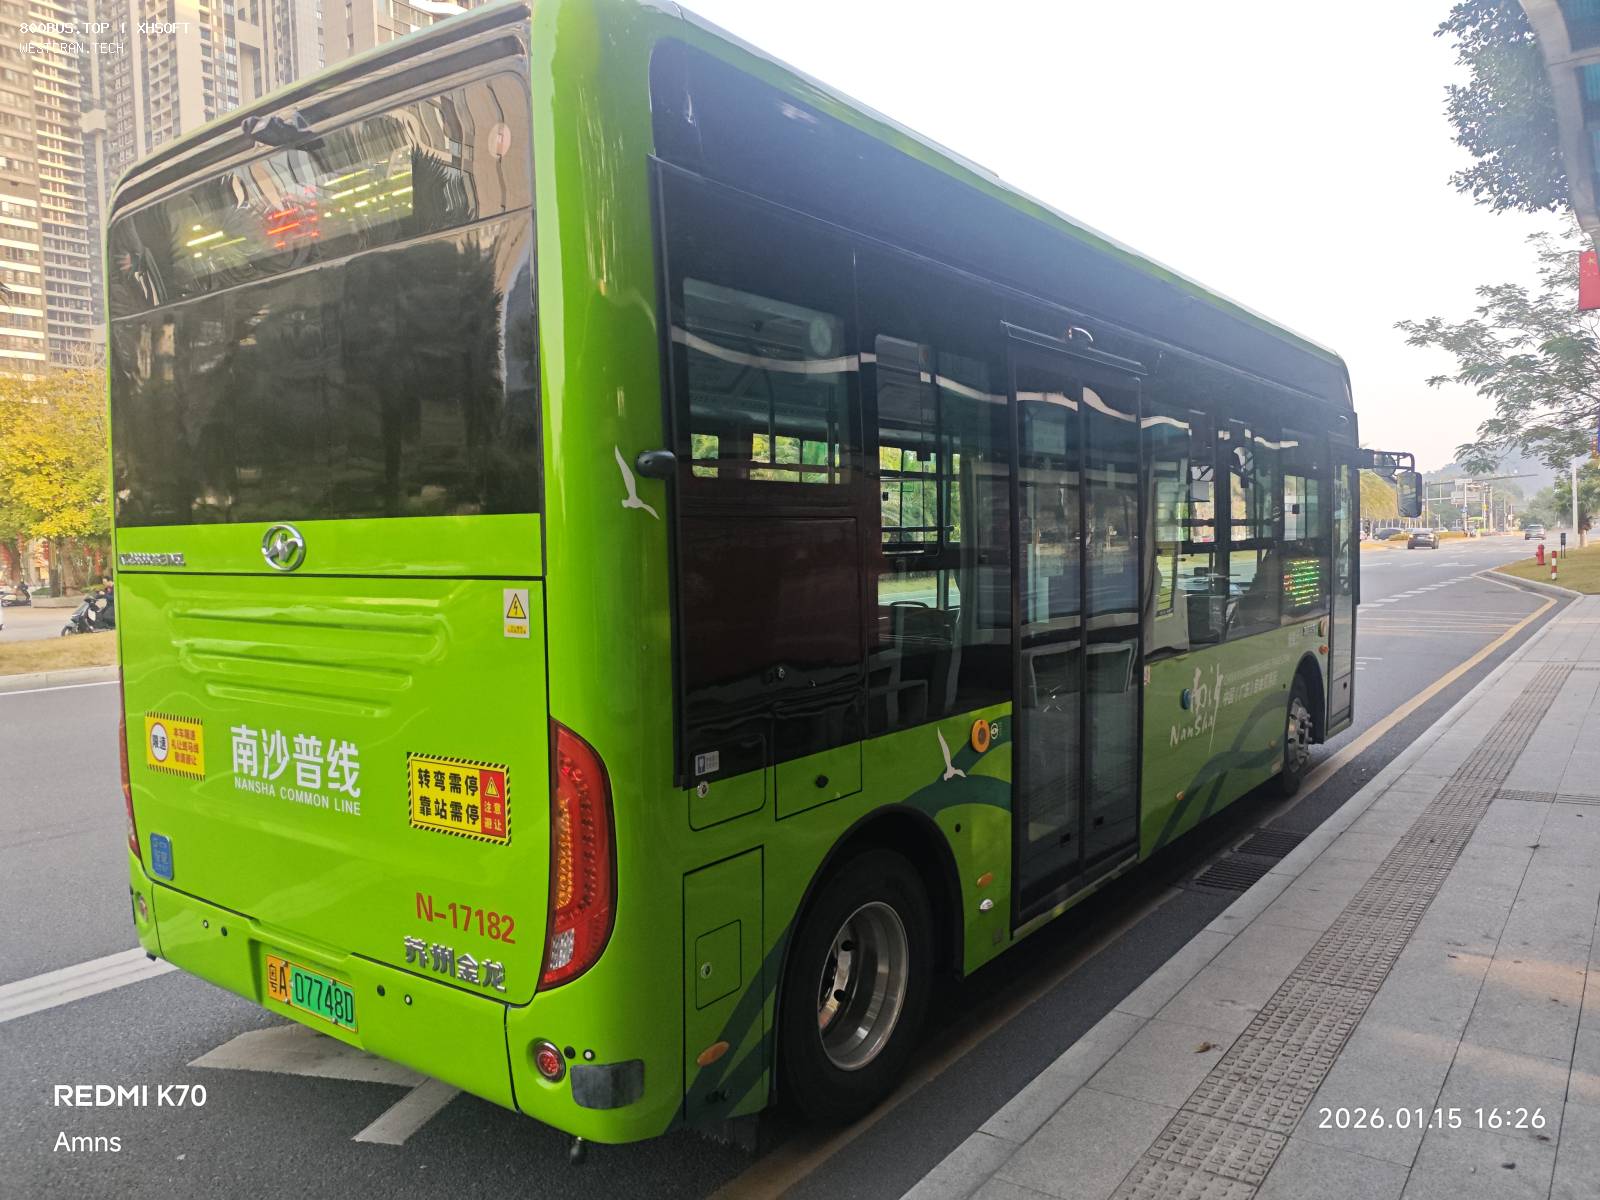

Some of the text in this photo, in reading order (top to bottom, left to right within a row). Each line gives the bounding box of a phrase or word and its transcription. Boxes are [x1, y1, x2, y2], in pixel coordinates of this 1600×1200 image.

[152, 734, 167, 750] 限速
[230, 724, 361, 798] 南沙普线
[234, 776, 361, 816] NANSHA COMMON LINE
[417, 767, 479, 796] 转弯需停
[419, 796, 480, 825] 靠站需停
[416, 892, 516, 944] N-17182
[404, 935, 507, 993] 苏州金龙
